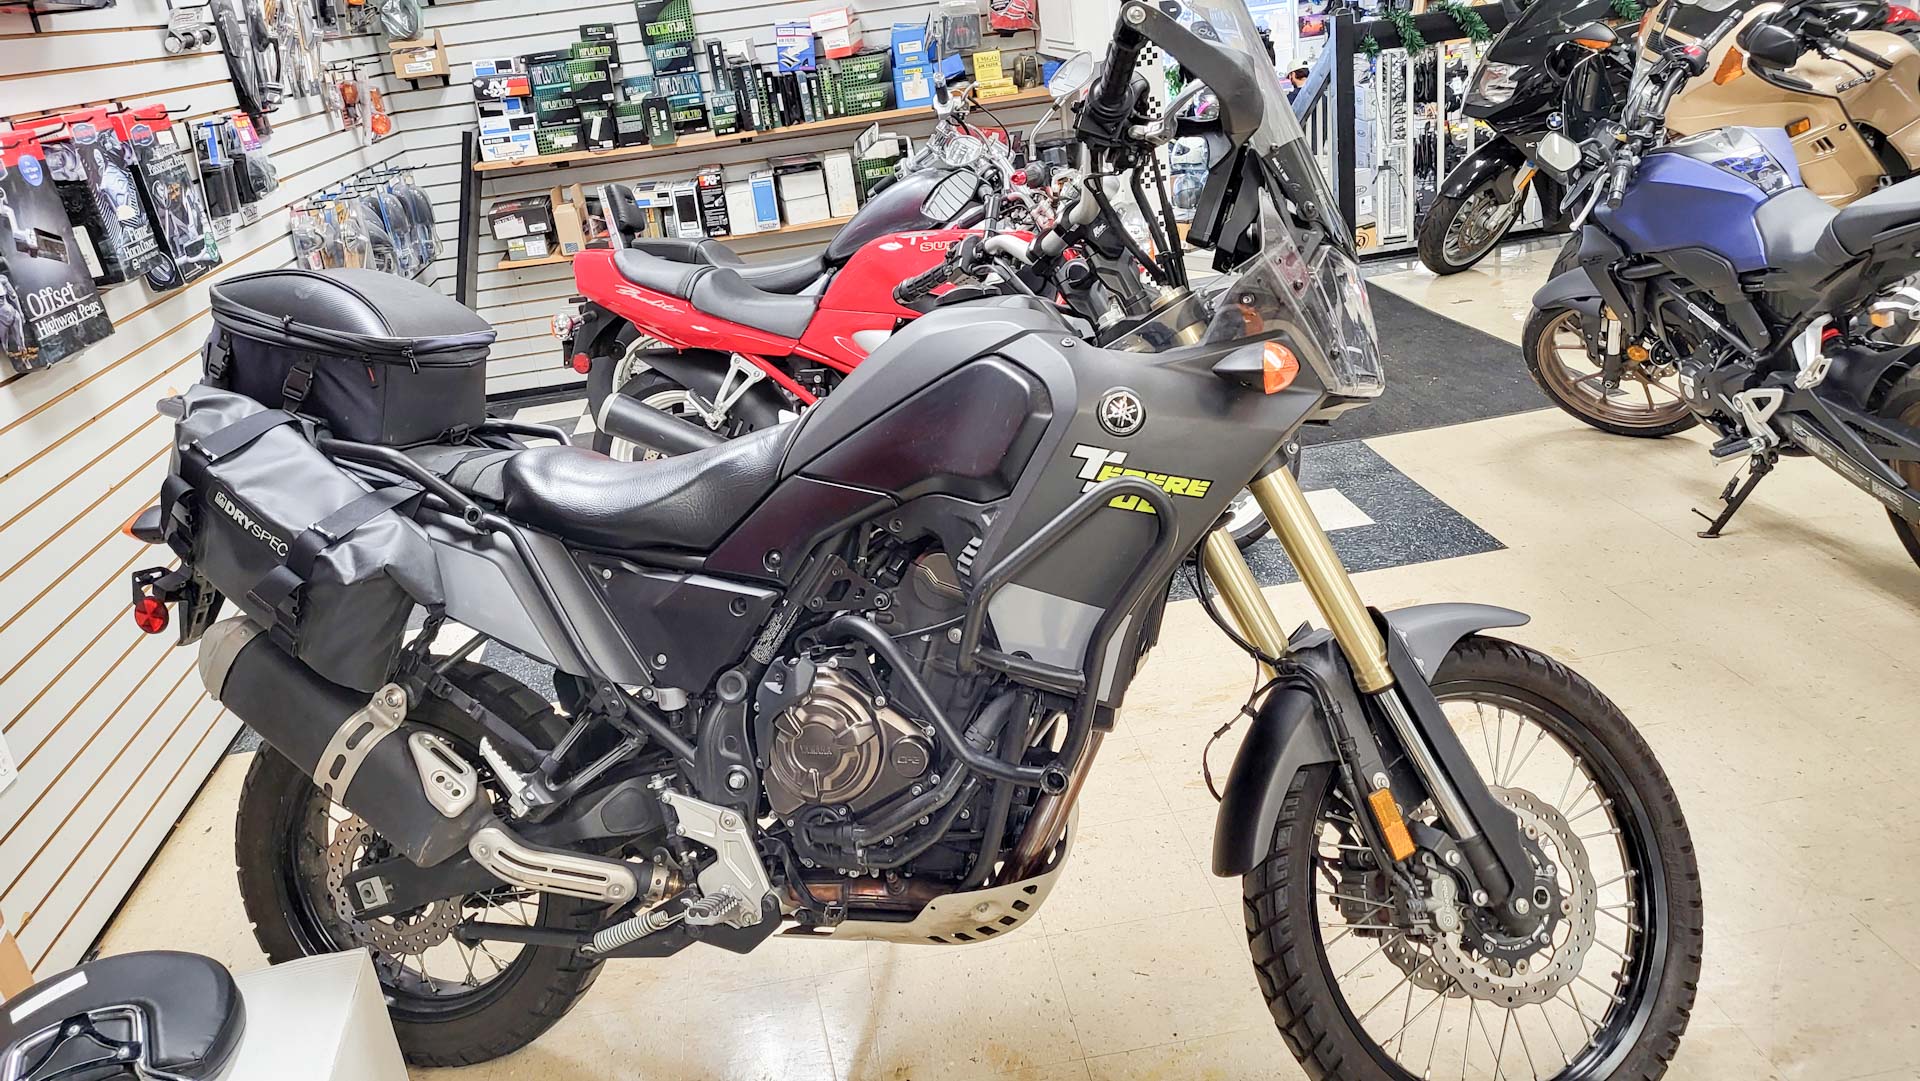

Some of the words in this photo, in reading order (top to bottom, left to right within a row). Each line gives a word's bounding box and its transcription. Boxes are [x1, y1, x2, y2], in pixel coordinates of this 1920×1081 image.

[26, 281, 80, 319] Offset
[34, 309, 79, 339] Highway
[77, 301, 101, 319] Pegs
